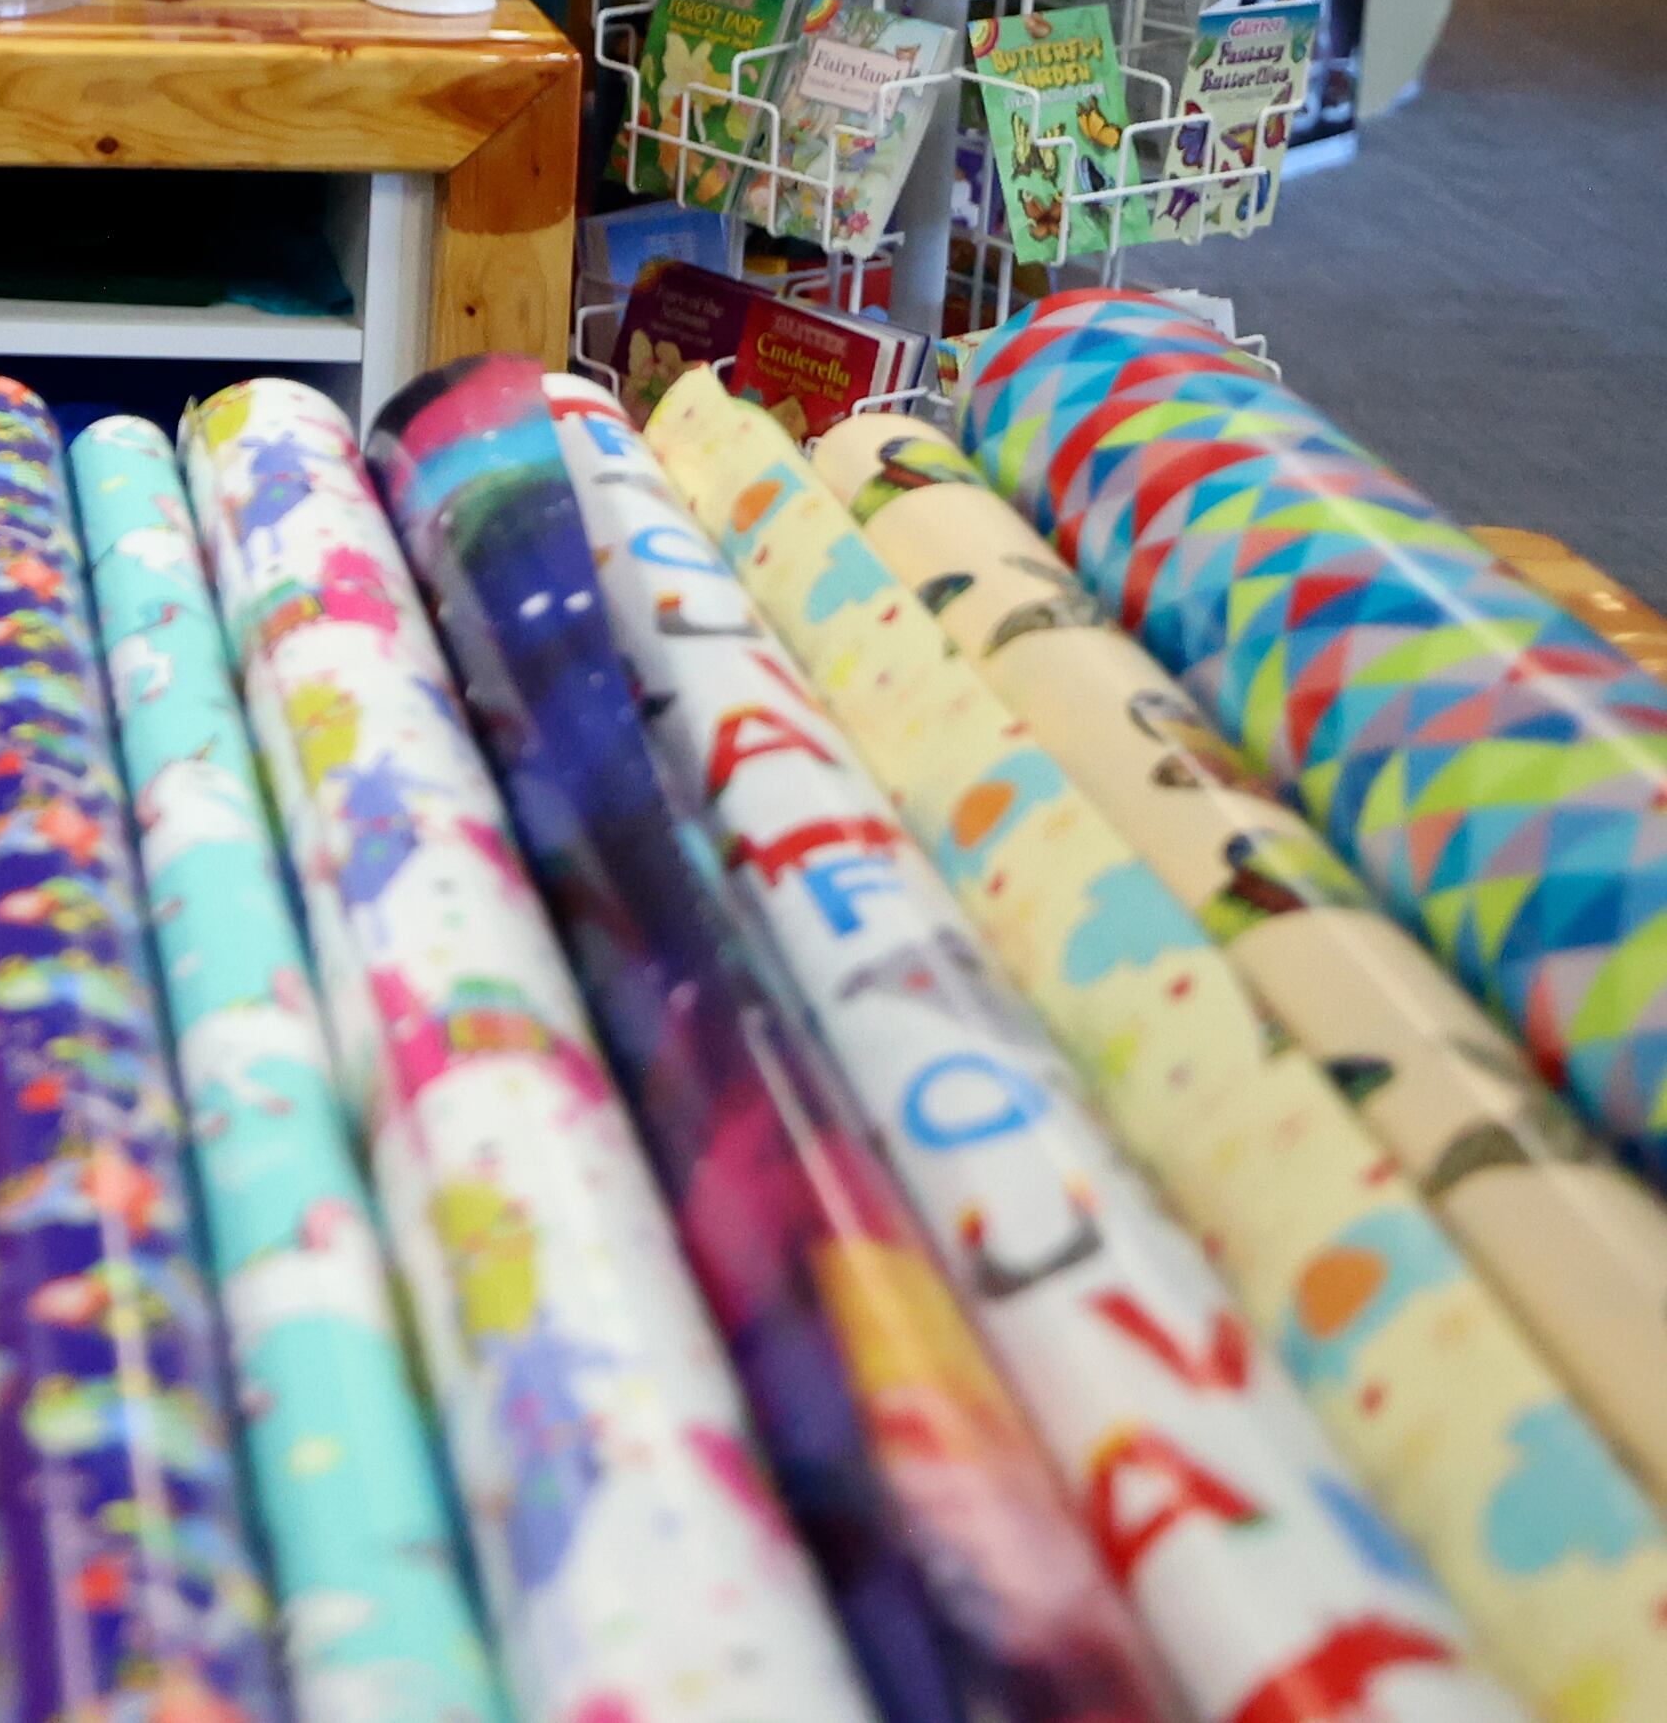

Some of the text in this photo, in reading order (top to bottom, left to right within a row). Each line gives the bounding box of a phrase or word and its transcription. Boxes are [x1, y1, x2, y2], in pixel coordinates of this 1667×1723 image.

[723, 8, 764, 37] FAIRY
[813, 49, 900, 83] Fairyland
[1218, 42, 1284, 66] Fantasy
[1200, 66, 1290, 93] Butterflies
[757, 332, 852, 389] Cinderella
